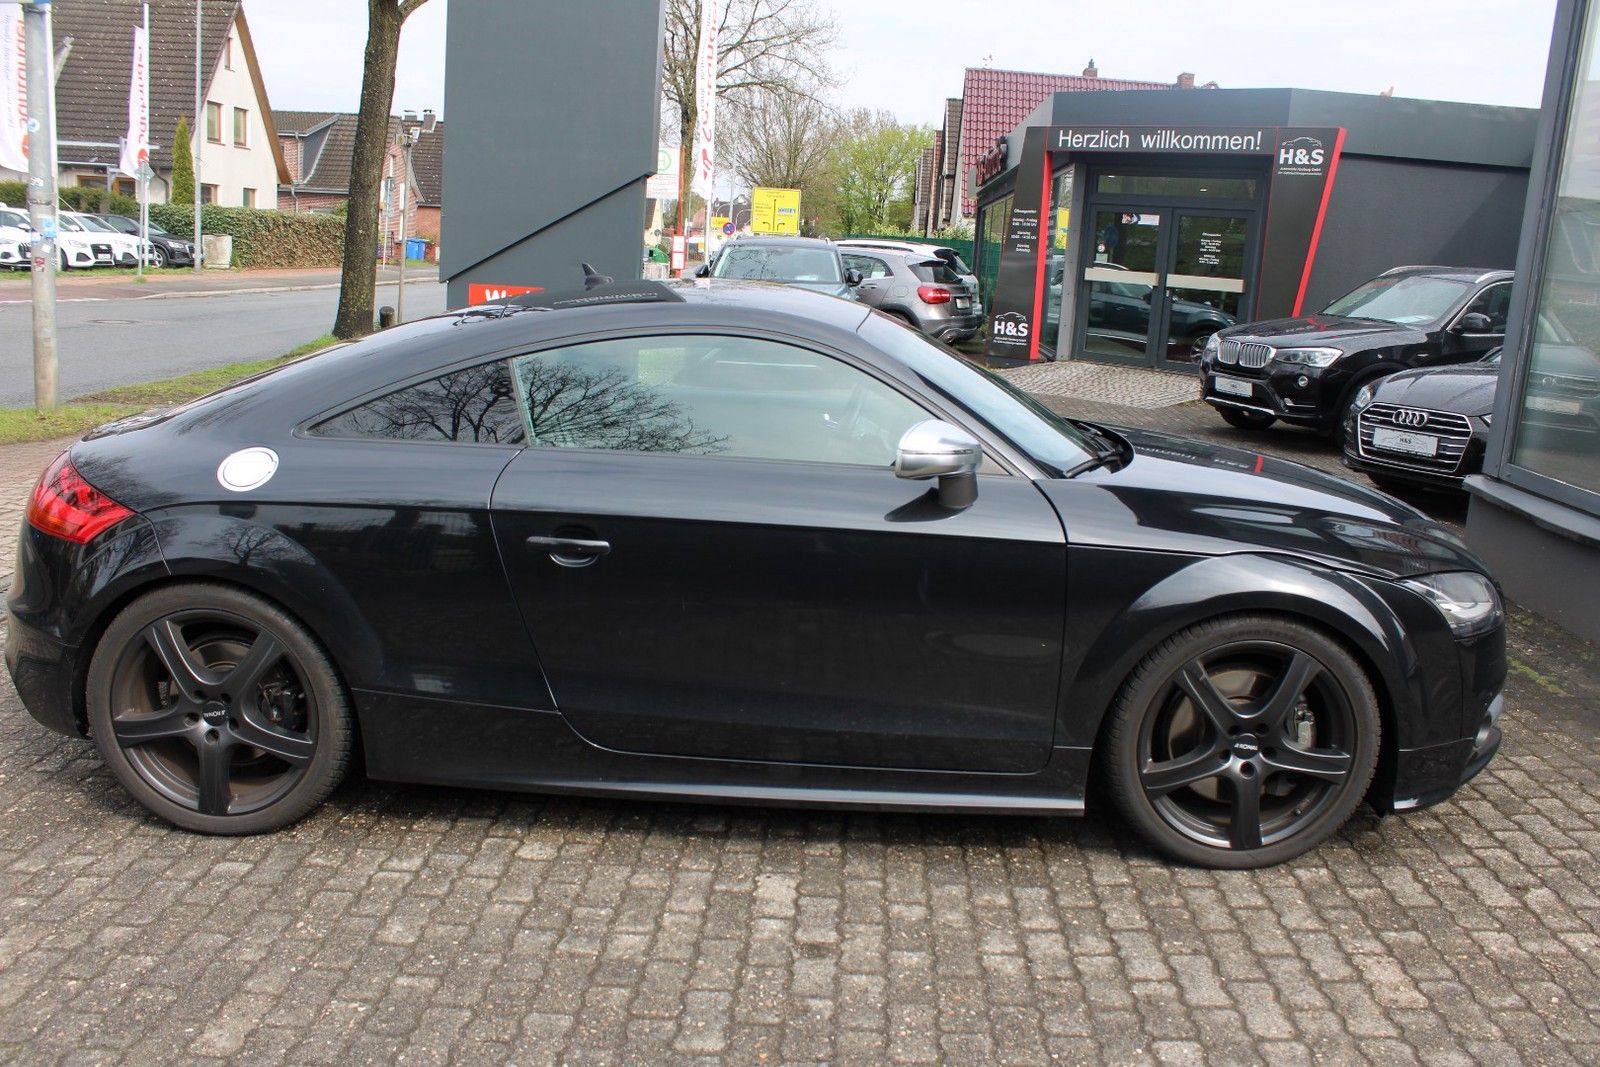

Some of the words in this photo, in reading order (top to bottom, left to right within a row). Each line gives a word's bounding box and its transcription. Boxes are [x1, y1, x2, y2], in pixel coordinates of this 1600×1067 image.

[1058, 130, 1129, 148] Herzlich
[1141, 130, 1263, 150] willkommen!
[1279, 148, 1324, 165] H&S
[994, 320, 1029, 336] H&S
